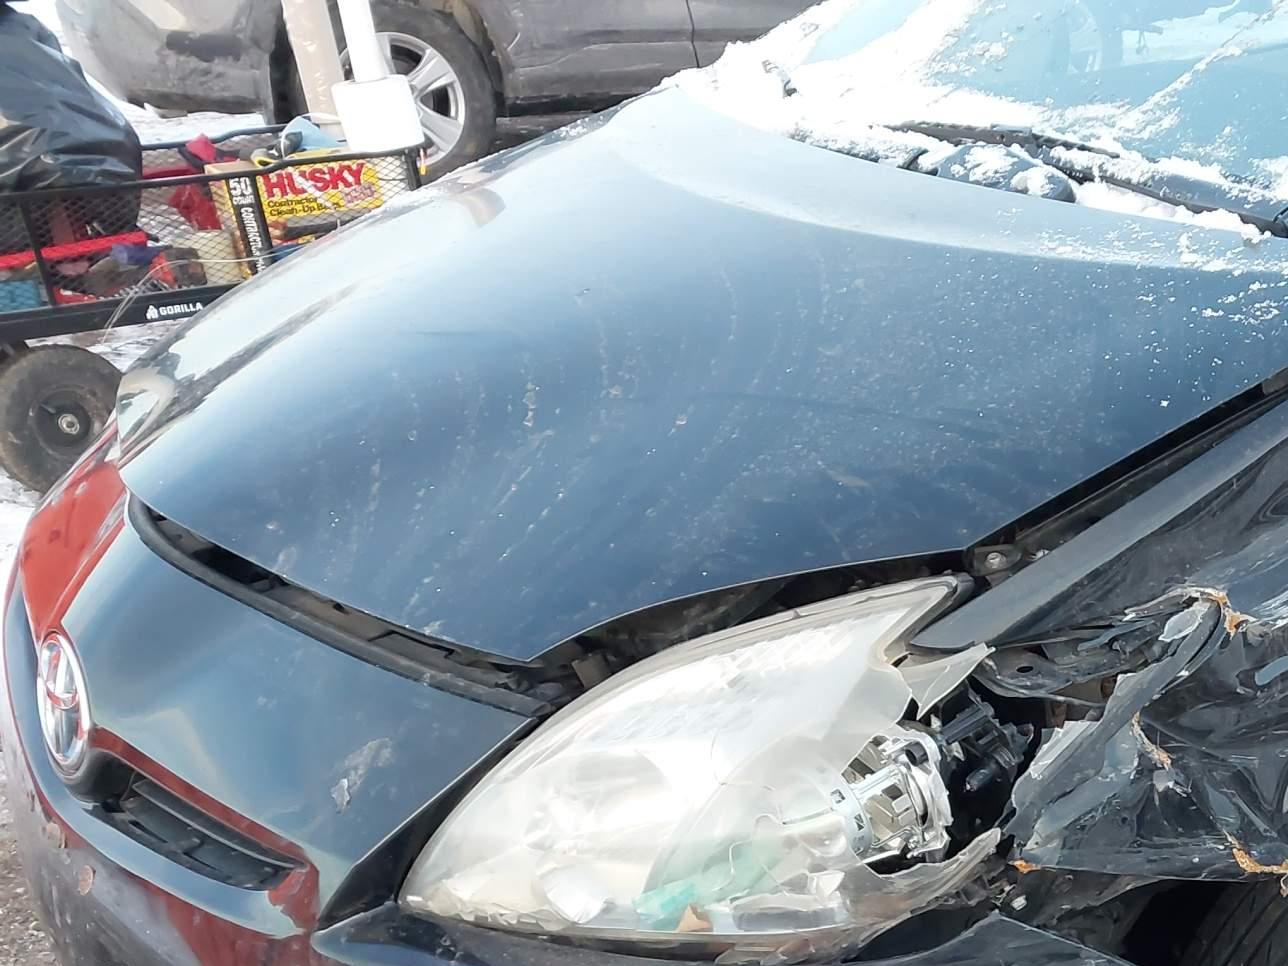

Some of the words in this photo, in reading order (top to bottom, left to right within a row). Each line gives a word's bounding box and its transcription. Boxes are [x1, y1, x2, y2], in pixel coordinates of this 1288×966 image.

[229, 177, 252, 196] 50
[261, 161, 365, 198] HUSKY
[159, 302, 204, 316] GORILLA
